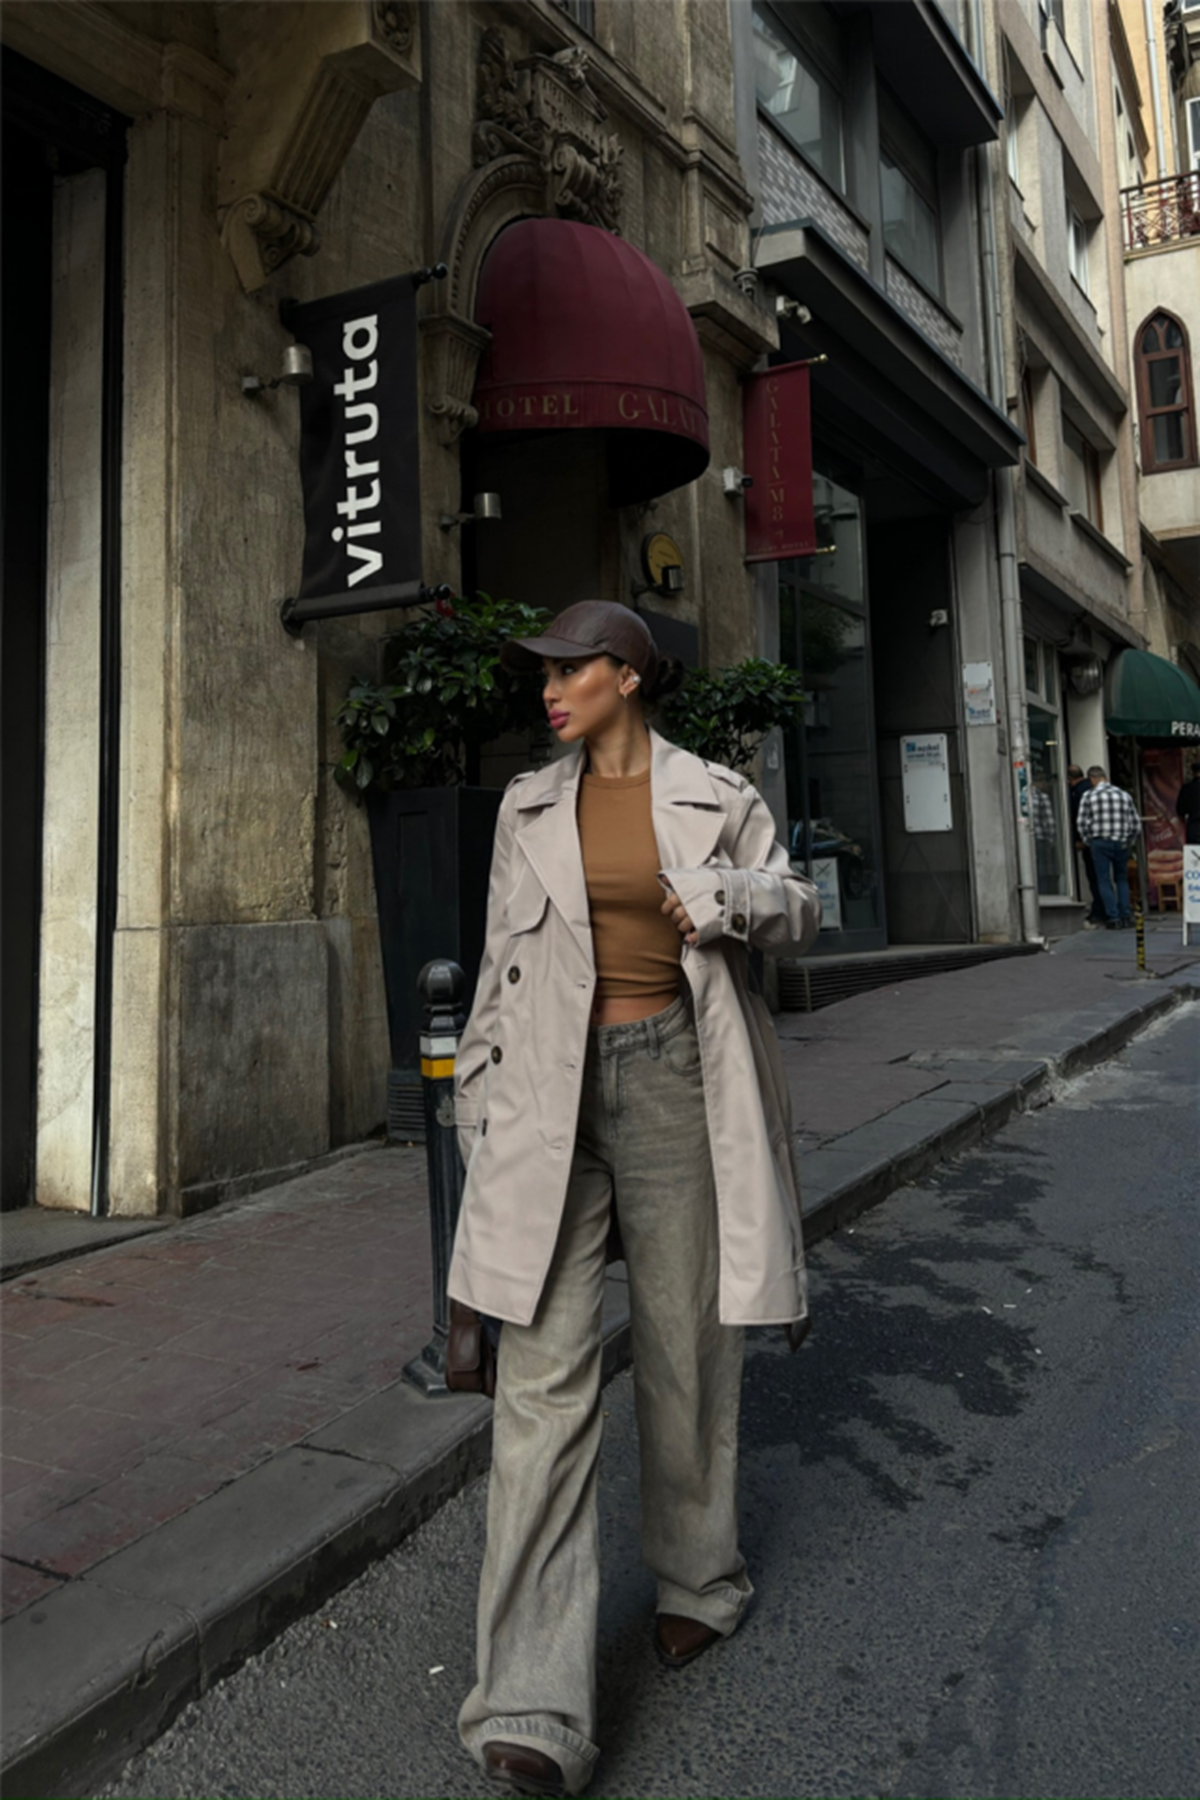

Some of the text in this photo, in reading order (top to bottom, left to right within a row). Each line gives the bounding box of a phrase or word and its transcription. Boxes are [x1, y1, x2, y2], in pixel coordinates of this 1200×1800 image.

[477, 393, 580, 421] HOTEL
[766, 378, 783, 479] GALATA
[331, 313, 384, 588] vitruta
[1170, 720, 1200, 738] PERA
